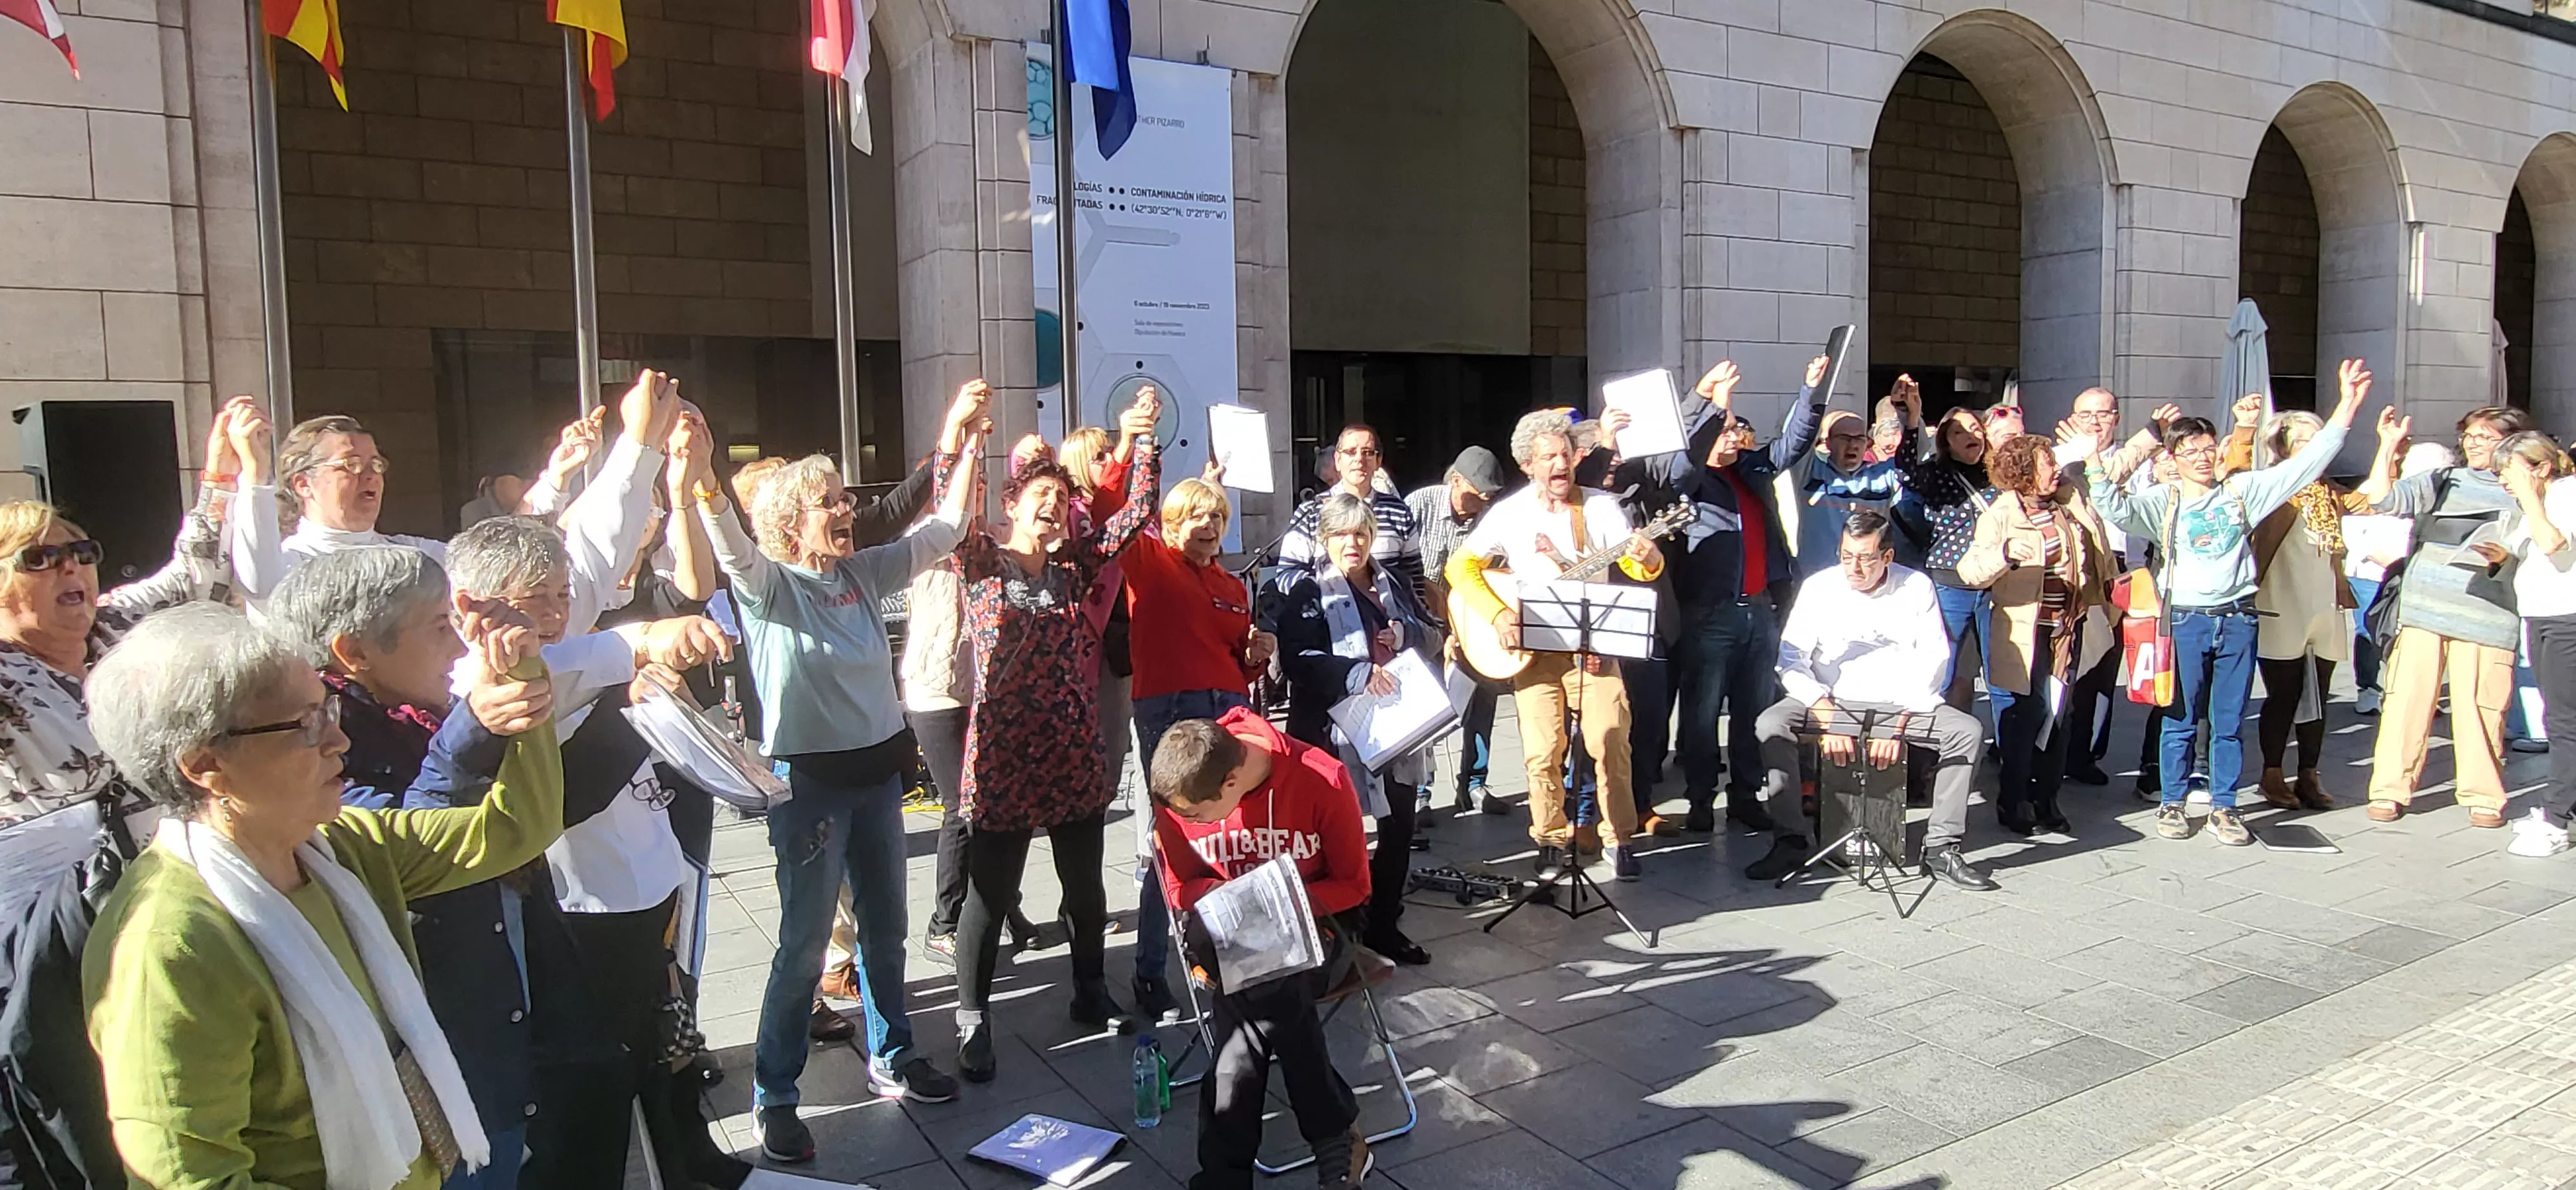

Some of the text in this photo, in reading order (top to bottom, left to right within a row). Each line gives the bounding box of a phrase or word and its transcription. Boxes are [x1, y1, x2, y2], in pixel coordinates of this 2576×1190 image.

[1138, 115, 1155, 126] THER
[1074, 180, 1103, 193] LOGÍAS
[1131, 187, 1226, 203] CONTAMINACIÓN HÍDRICA
